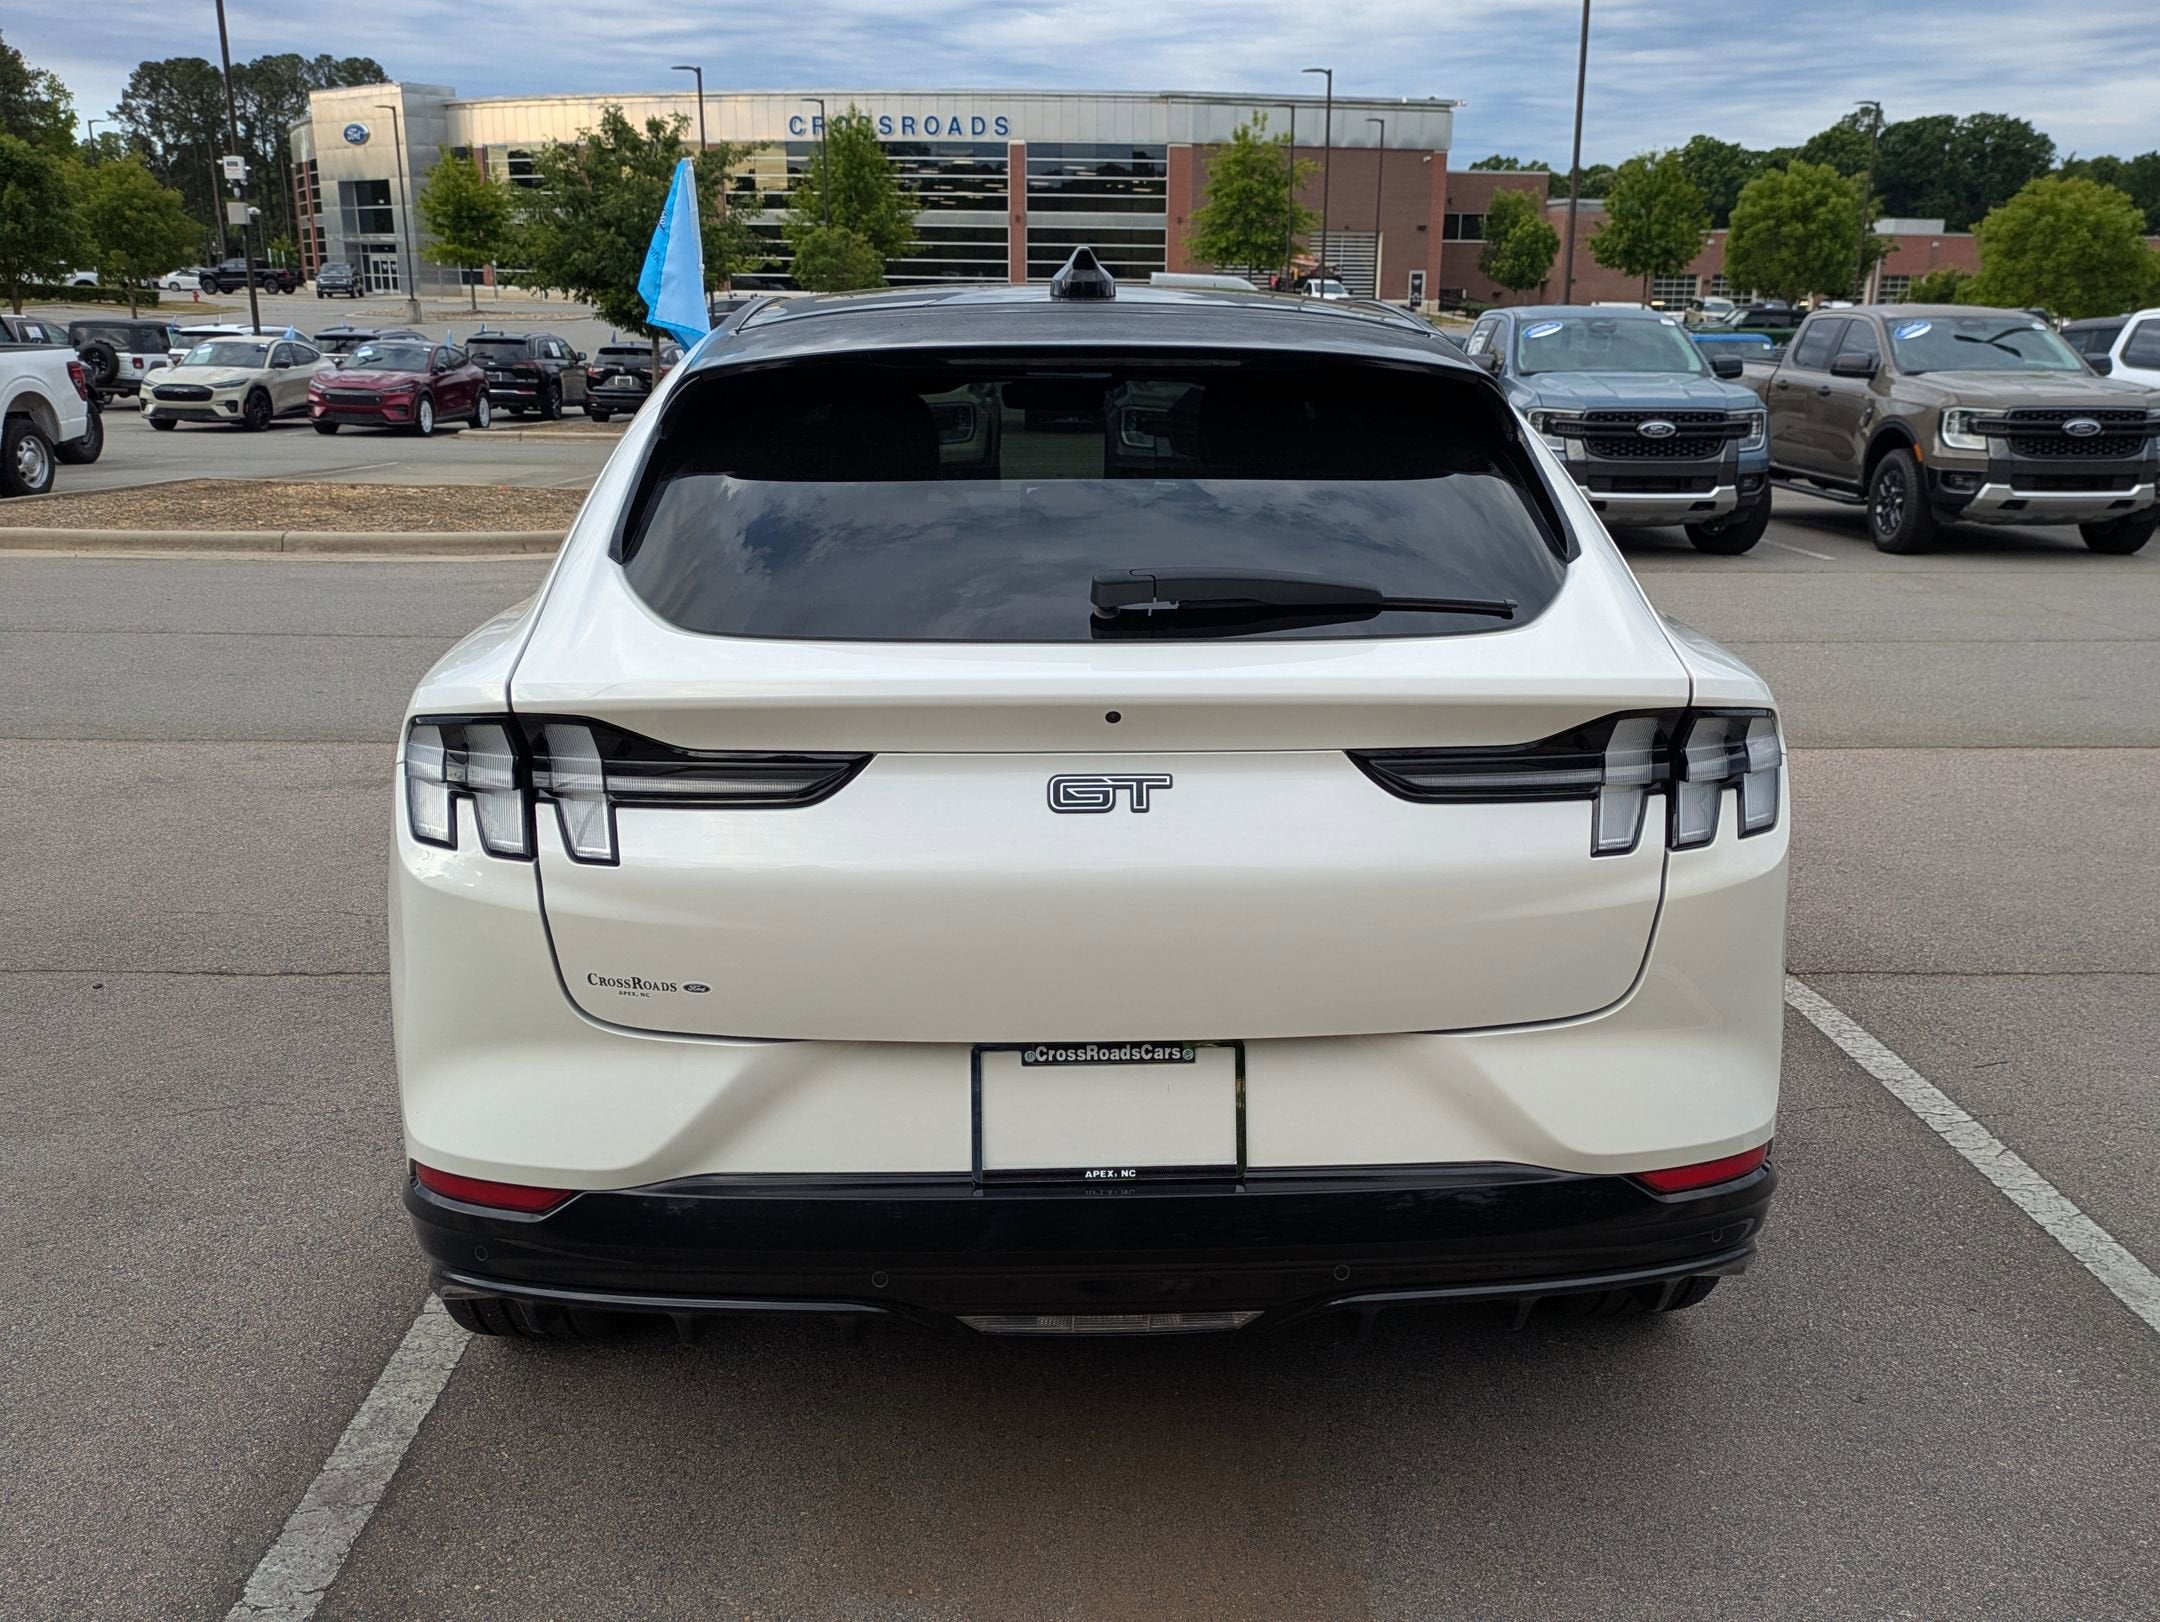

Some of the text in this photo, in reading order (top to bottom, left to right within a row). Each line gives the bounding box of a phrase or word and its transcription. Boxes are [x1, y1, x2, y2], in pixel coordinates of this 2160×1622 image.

[788, 115, 1010, 136] CRSROADS
[1047, 773, 1173, 813] GT
[618, 990, 639, 998] APEX,
[685, 984, 708, 992] Ford
[1035, 1044, 1181, 1062] CrossRoadsCars
[1084, 1169, 1136, 1179] APEX, NC
